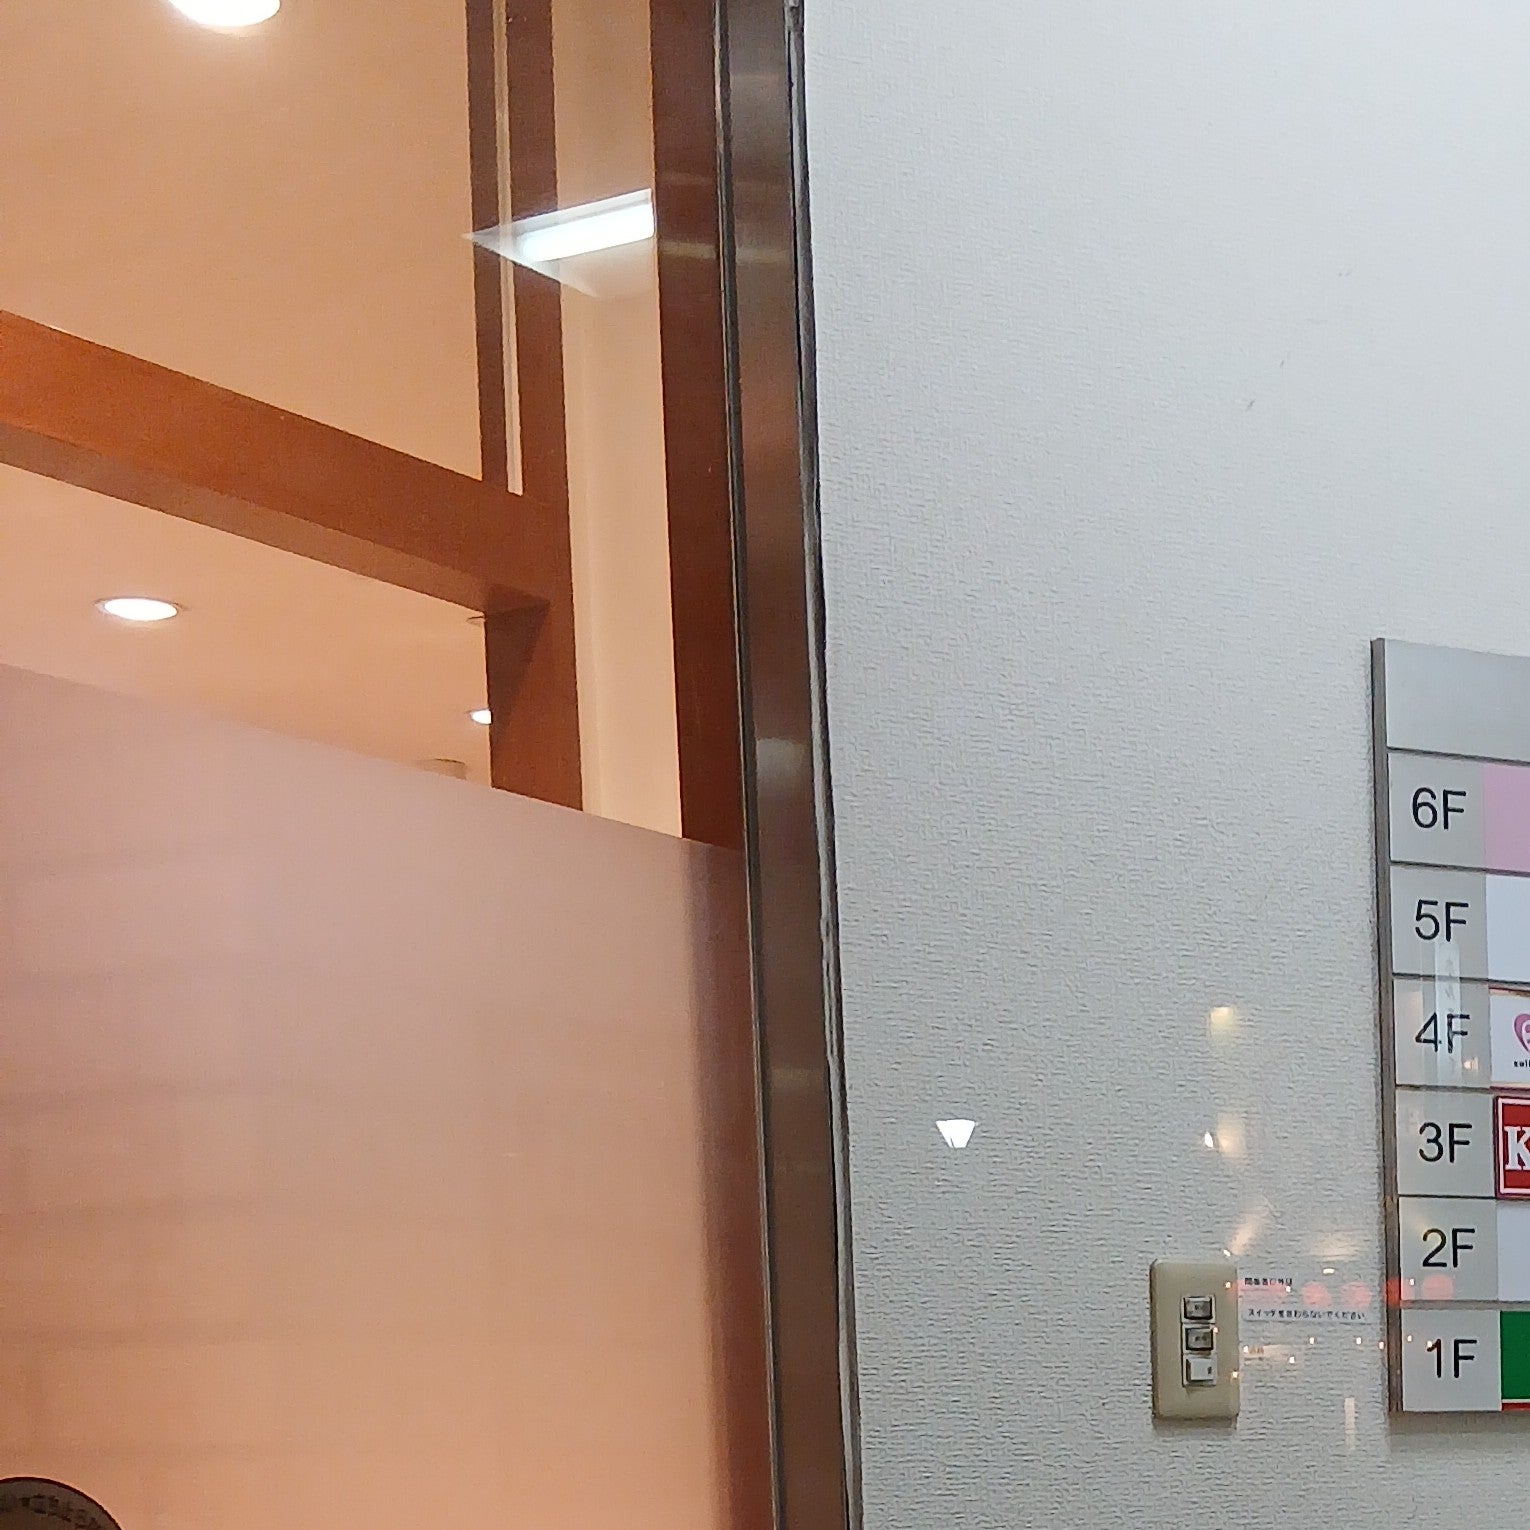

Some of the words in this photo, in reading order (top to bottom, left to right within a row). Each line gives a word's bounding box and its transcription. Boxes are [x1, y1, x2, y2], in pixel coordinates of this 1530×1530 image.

[1411, 787, 1467, 832] 6F
[1414, 900, 1470, 943] 5F
[1415, 1013, 1471, 1056] 4F
[1418, 1122, 1473, 1164] 3F
[1421, 1228, 1476, 1269] 2F
[1427, 1338, 1477, 1379] 1F
